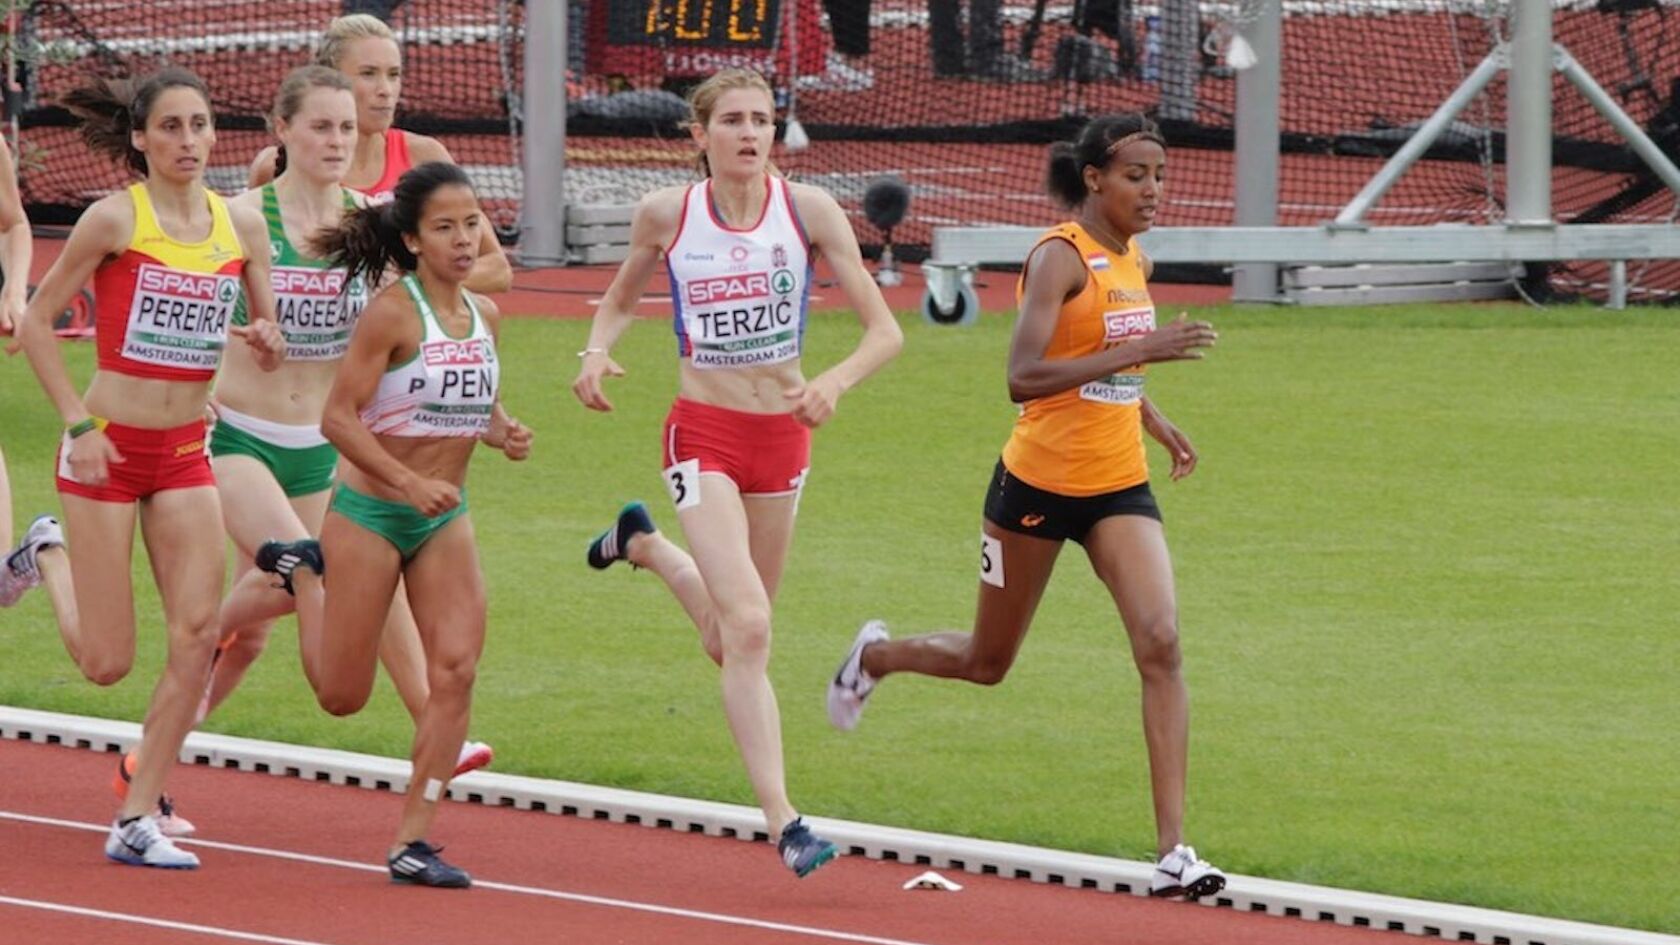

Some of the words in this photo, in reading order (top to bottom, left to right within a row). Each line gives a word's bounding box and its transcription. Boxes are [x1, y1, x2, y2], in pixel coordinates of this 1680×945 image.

[141, 269, 215, 298] SPAR
[271, 271, 342, 294] SPAR
[689, 276, 768, 304] SPAR
[137, 296, 227, 334] PEREIRA
[697, 295, 792, 338] TERZIĆ
[1108, 314, 1154, 337] SPAR
[126, 344, 201, 364] AMSTERDAM
[287, 346, 330, 357] TERDAM
[424, 342, 484, 364] SPAR
[694, 350, 775, 365] AMSTERDAM
[440, 368, 493, 398] PEN
[412, 413, 477, 428] AMSTERDAM
[671, 471, 687, 505] 3
[981, 541, 992, 573] 6
